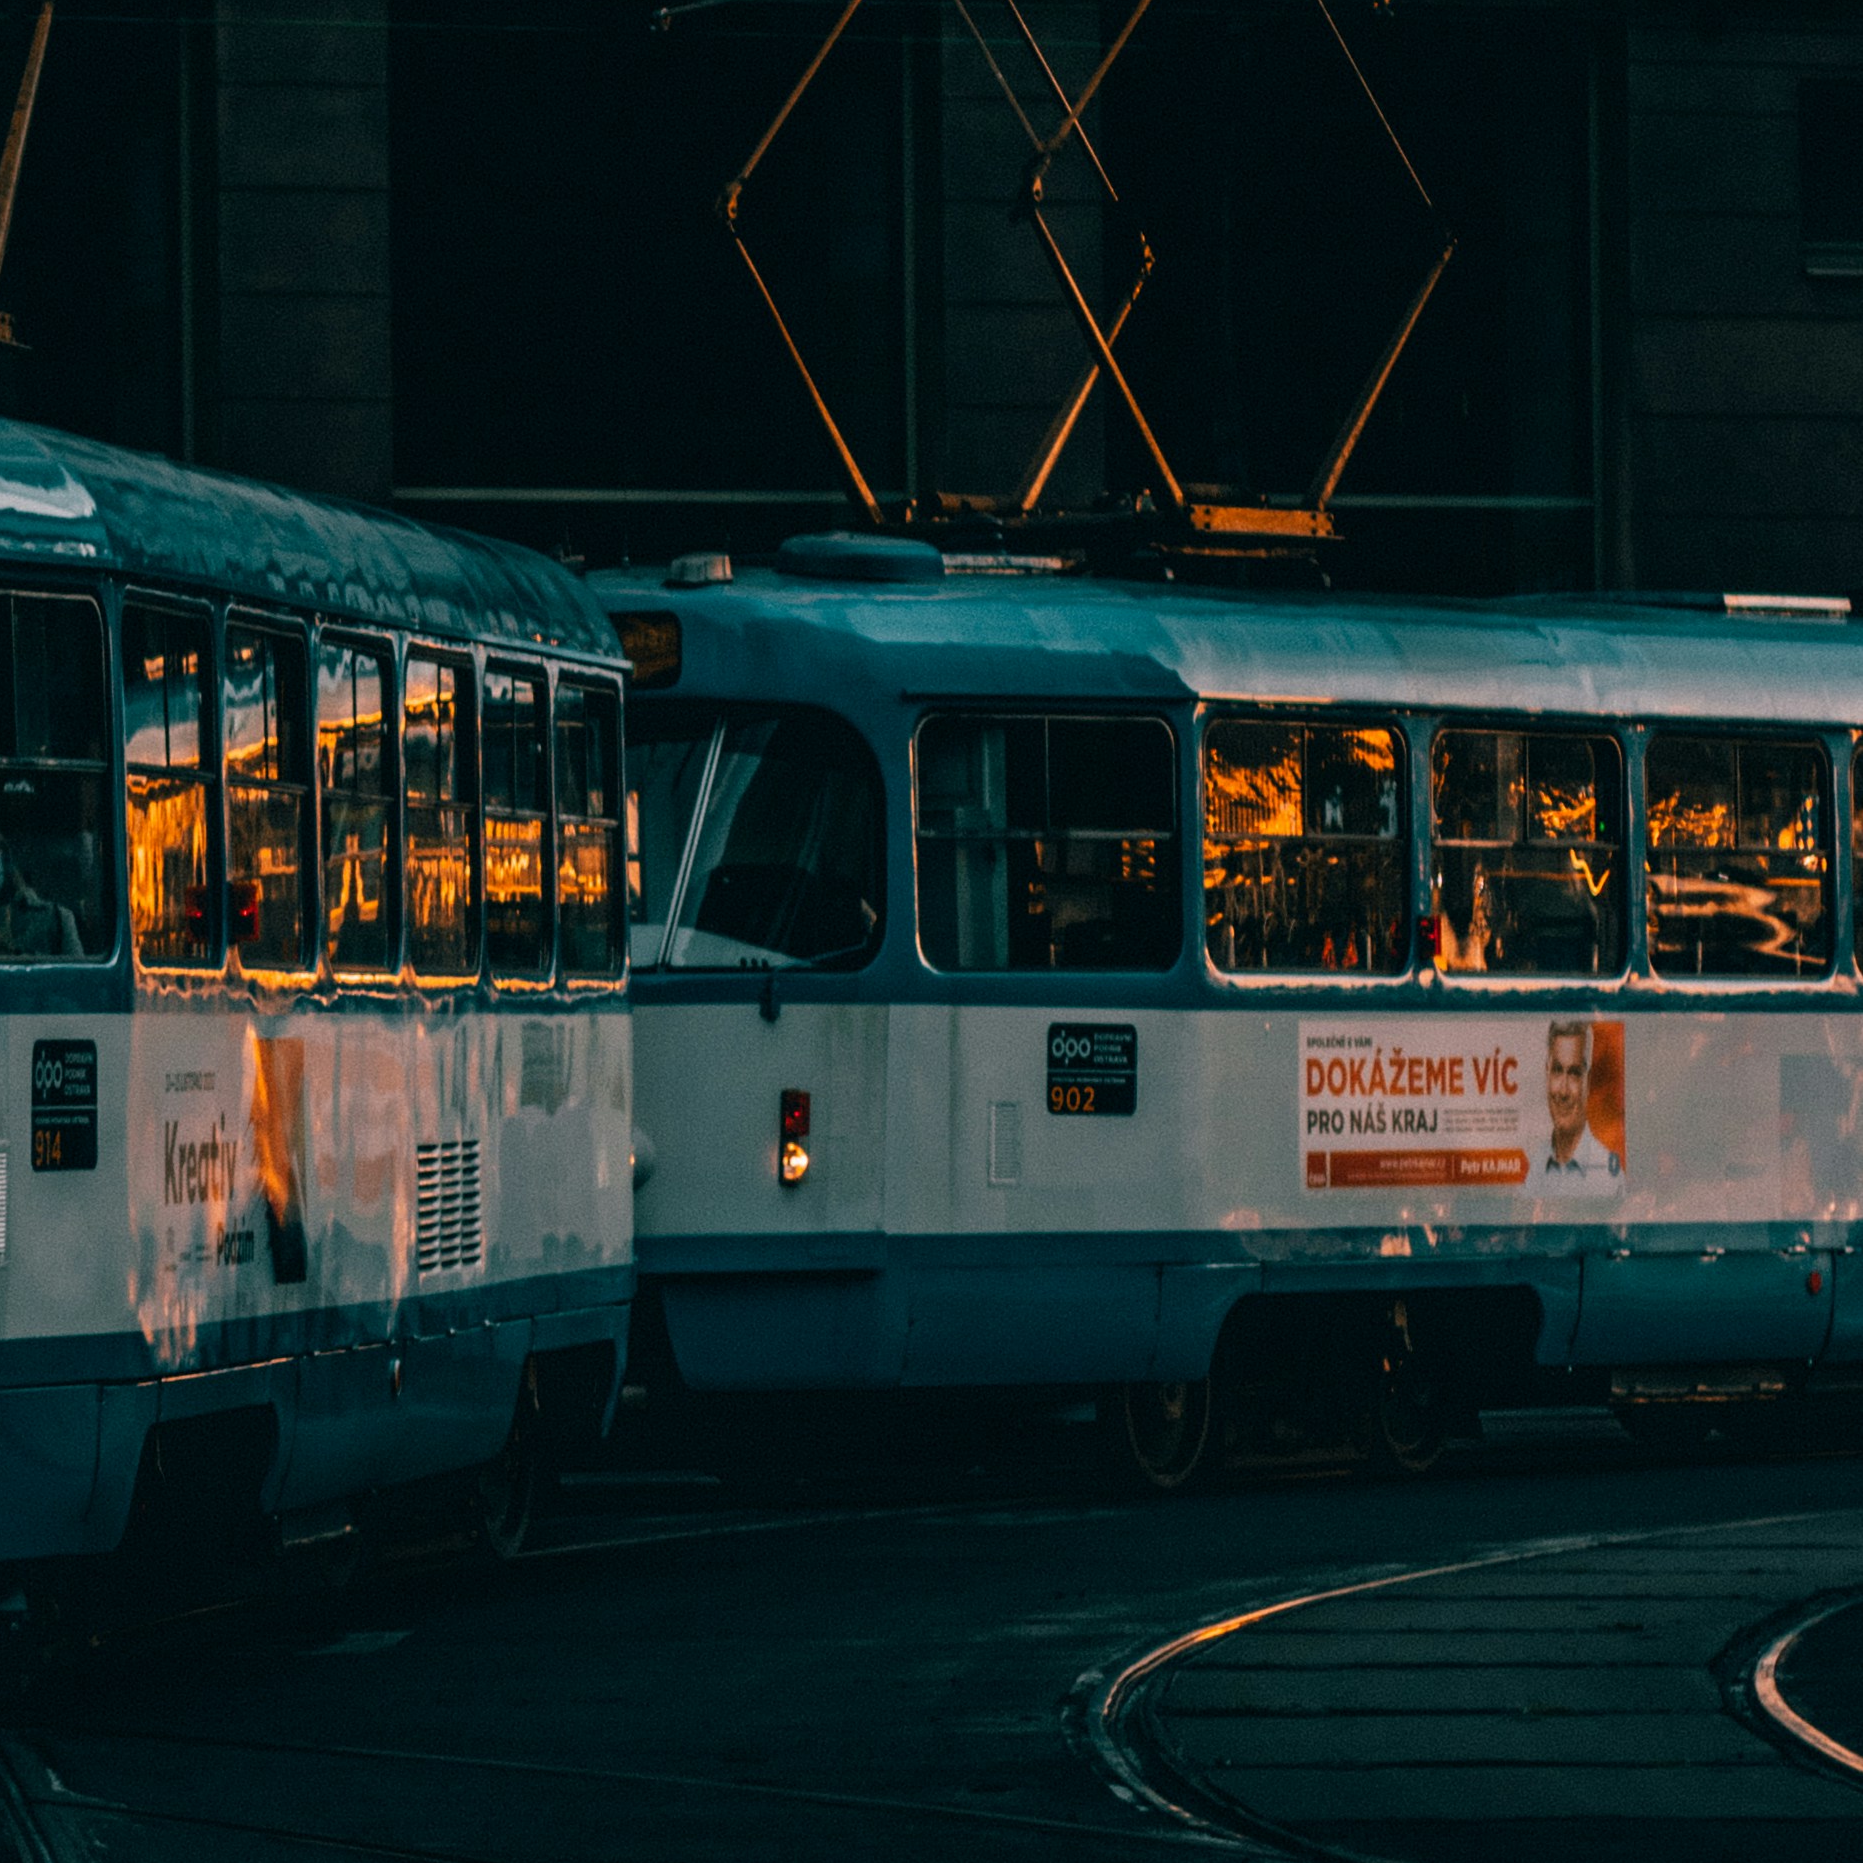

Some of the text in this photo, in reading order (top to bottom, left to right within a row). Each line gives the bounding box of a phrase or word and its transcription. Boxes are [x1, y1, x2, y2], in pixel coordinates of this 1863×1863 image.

[1306, 1046, 1519, 1096] DOKÁŽEME VÍC
[1050, 1084, 1096, 1113] 902
[1306, 1109, 1344, 1135] PRO
[1349, 1102, 1387, 1134] NÁŠ
[1391, 1109, 1439, 1134] KRAJ
[34, 1128, 63, 1168] 914
[164, 1110, 238, 1207] Kreativ
